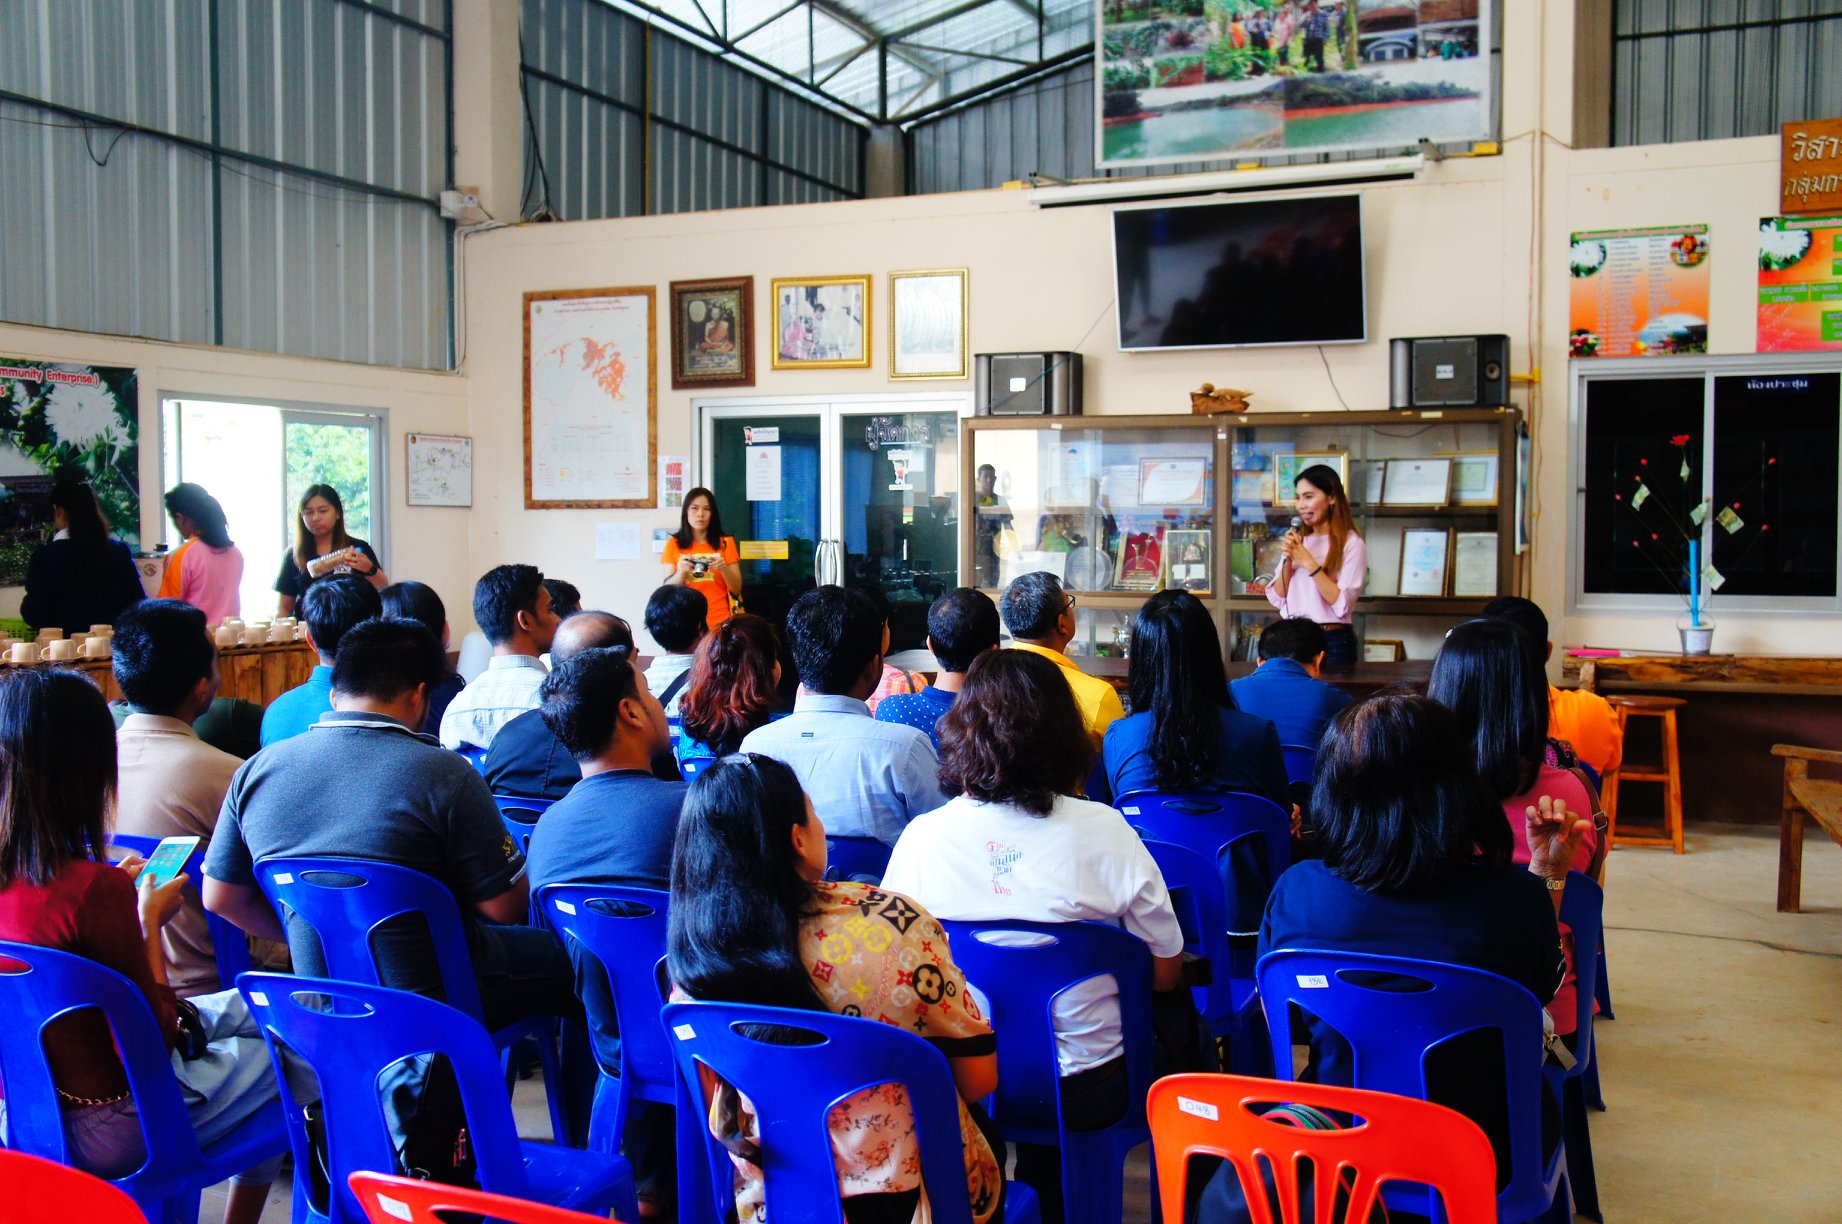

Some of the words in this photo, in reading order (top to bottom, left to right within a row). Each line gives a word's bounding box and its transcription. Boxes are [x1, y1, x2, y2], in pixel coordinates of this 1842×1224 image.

[1791, 132, 1842, 161] วิสา
[46, 370, 99, 386] Enterprise.)
[865, 417, 930, 451] ผู้จัดการ
